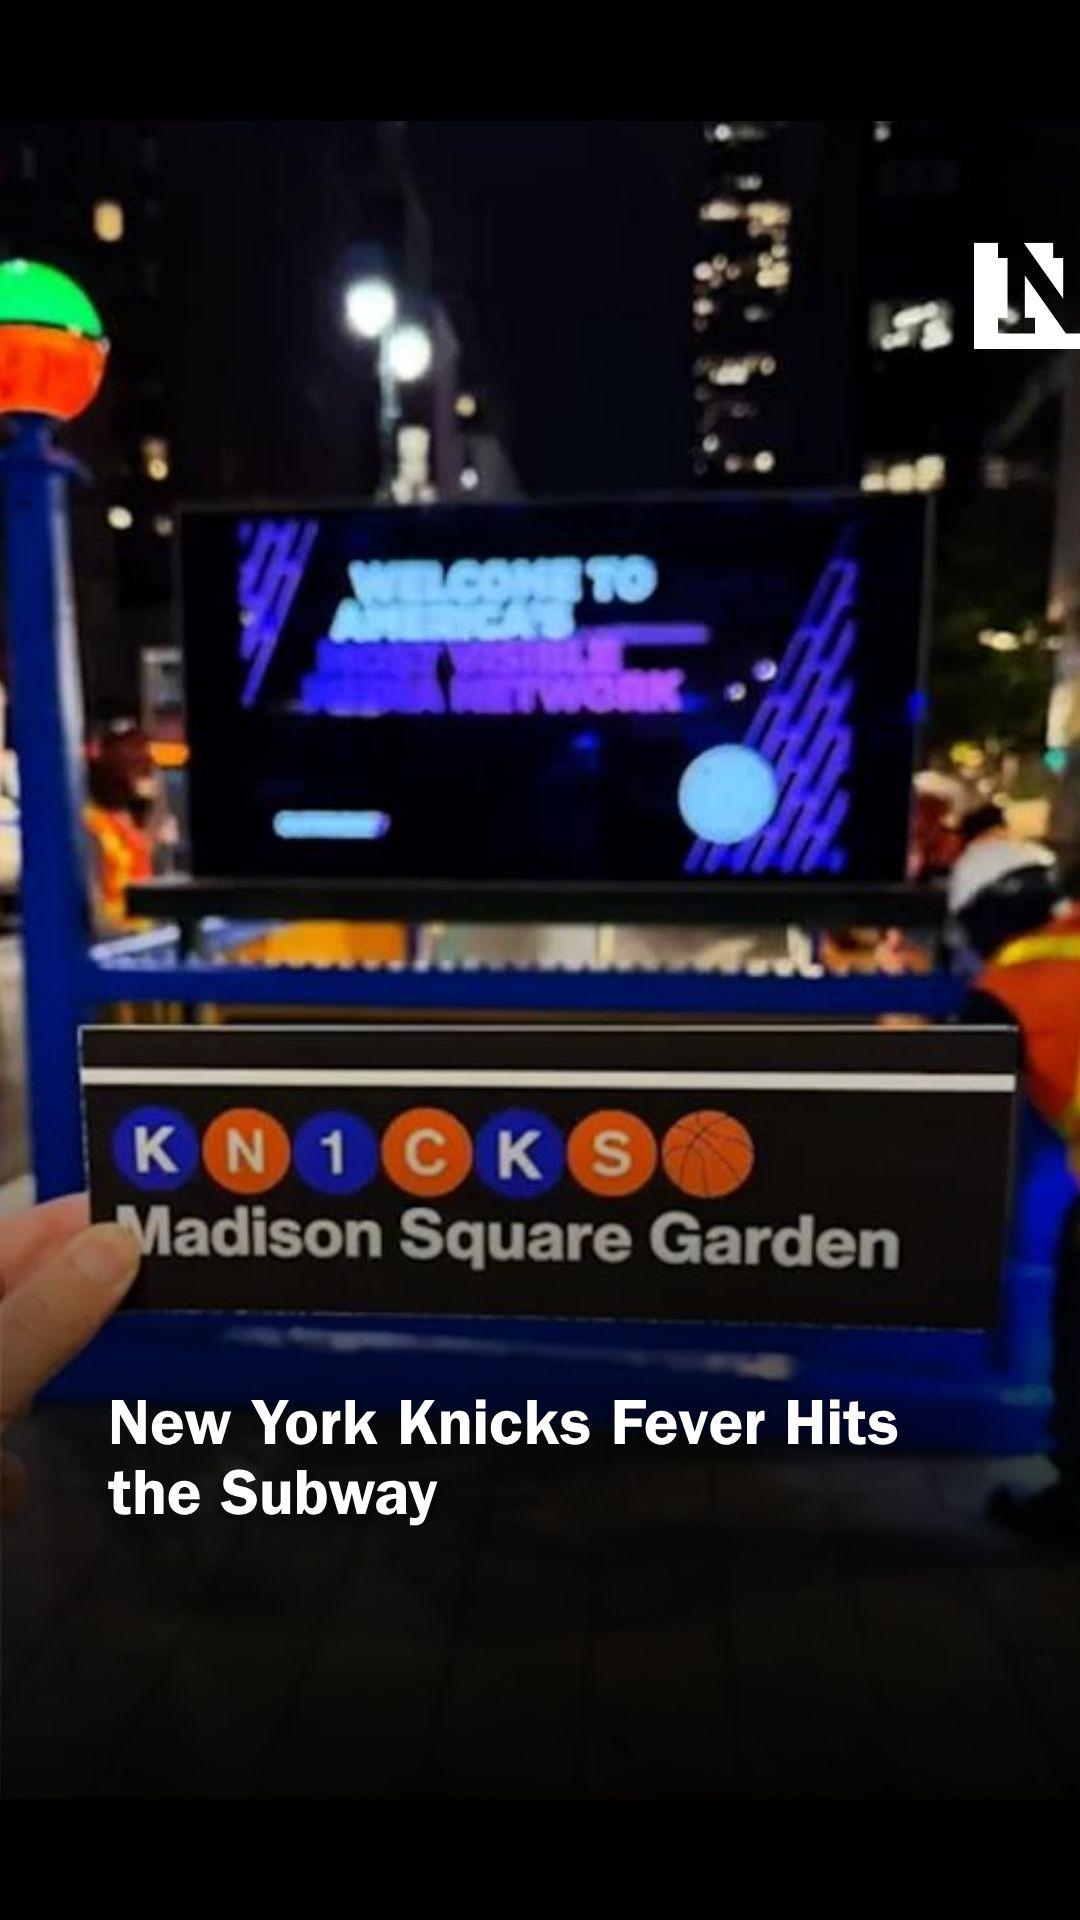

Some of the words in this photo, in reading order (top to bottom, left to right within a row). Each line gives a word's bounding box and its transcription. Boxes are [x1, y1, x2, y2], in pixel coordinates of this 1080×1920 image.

[347, 558, 582, 603] WELCOME
[585, 554, 657, 603] TO
[116, 1205, 382, 1257] Madison
[400, 1207, 632, 1270] Square
[650, 1211, 898, 1269] Garden
